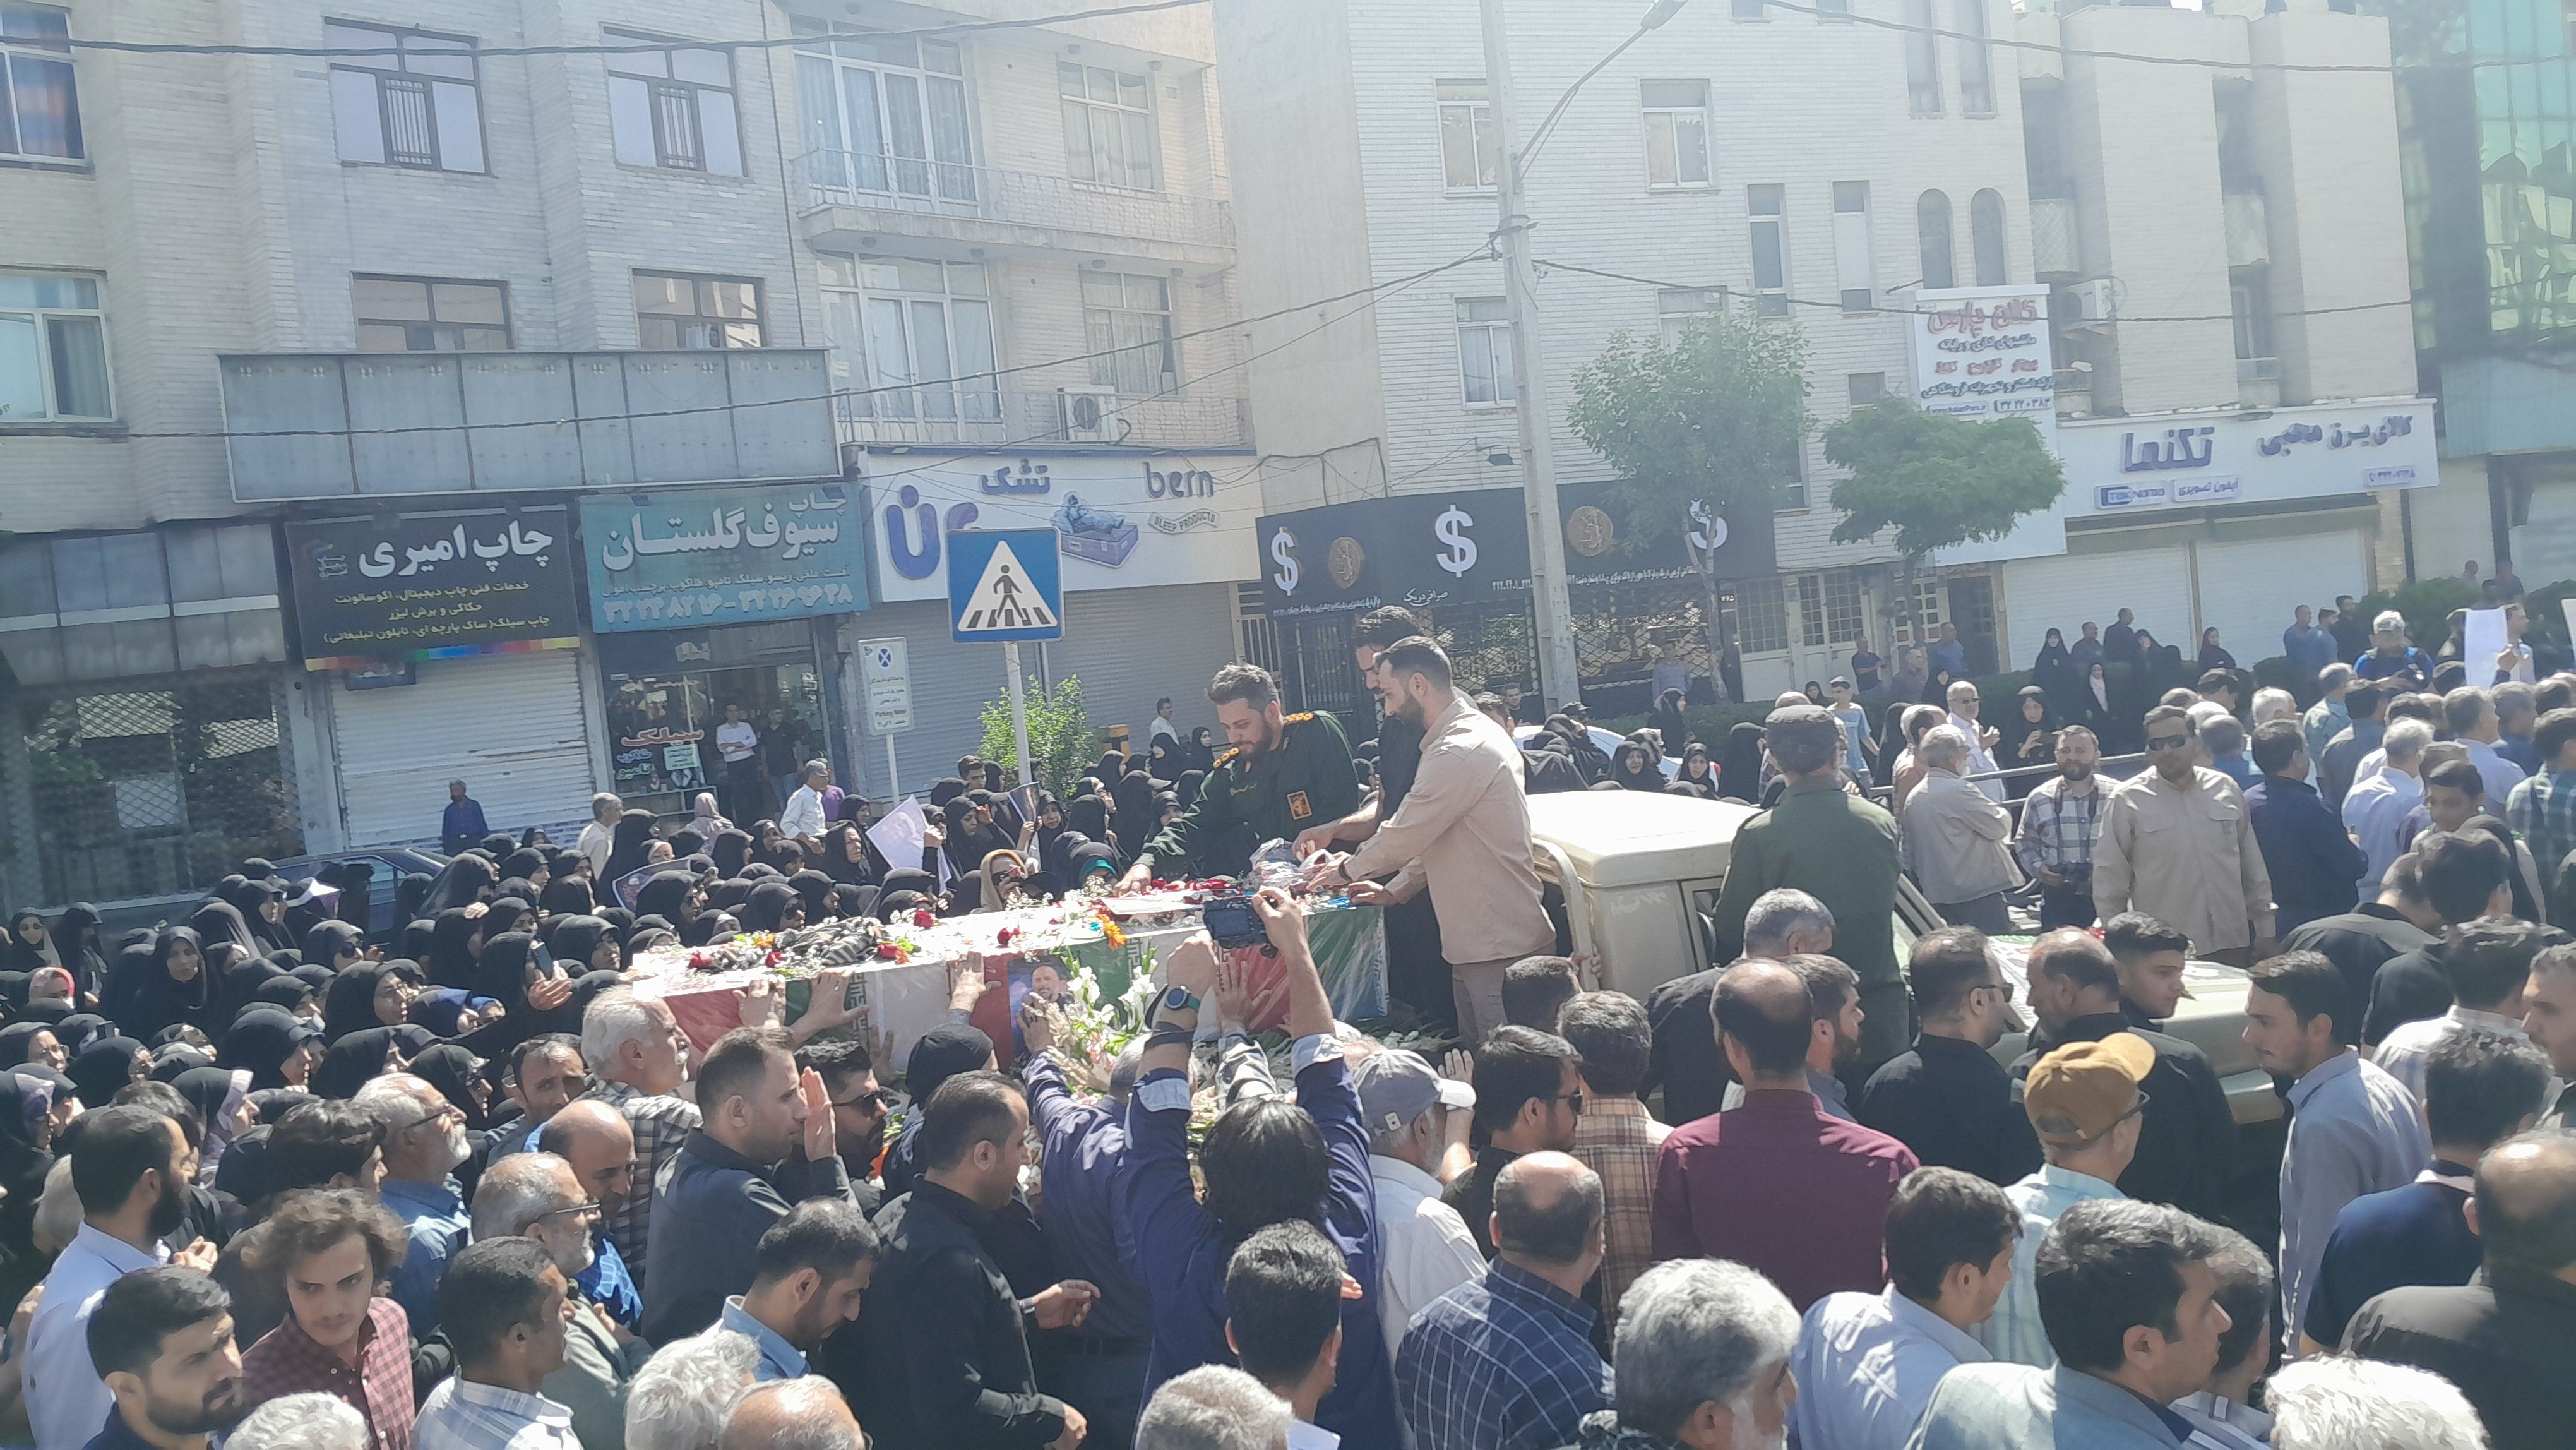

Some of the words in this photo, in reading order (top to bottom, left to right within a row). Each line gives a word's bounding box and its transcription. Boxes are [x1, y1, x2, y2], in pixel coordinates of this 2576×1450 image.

[2329, 423, 2370, 450] برق
[2121, 427, 2215, 474] تکنما
[978, 459, 1050, 495] تشک
[1142, 461, 1214, 498] bern
[789, 492, 847, 517] چاپ
[1154, 514, 1176, 530] SLEEP
[1179, 509, 1216, 529] PRODUCTS
[472, 518, 554, 573] چاپ
[602, 506, 746, 570] گلستان
[358, 523, 467, 578] امیری
[444, 586, 468, 600] چاپ
[470, 584, 491, 596] فنی
[492, 581, 530, 592] خدمات
[1409, 589, 1449, 607] صرافی
[388, 609, 409, 621] لیزر
[412, 606, 436, 619] برش
[439, 606, 446, 616] و
[431, 622, 460, 634] پارچه
[527, 615, 550, 629] چاپ
[621, 726, 705, 746] سیلک
[617, 763, 652, 780] تامپو
